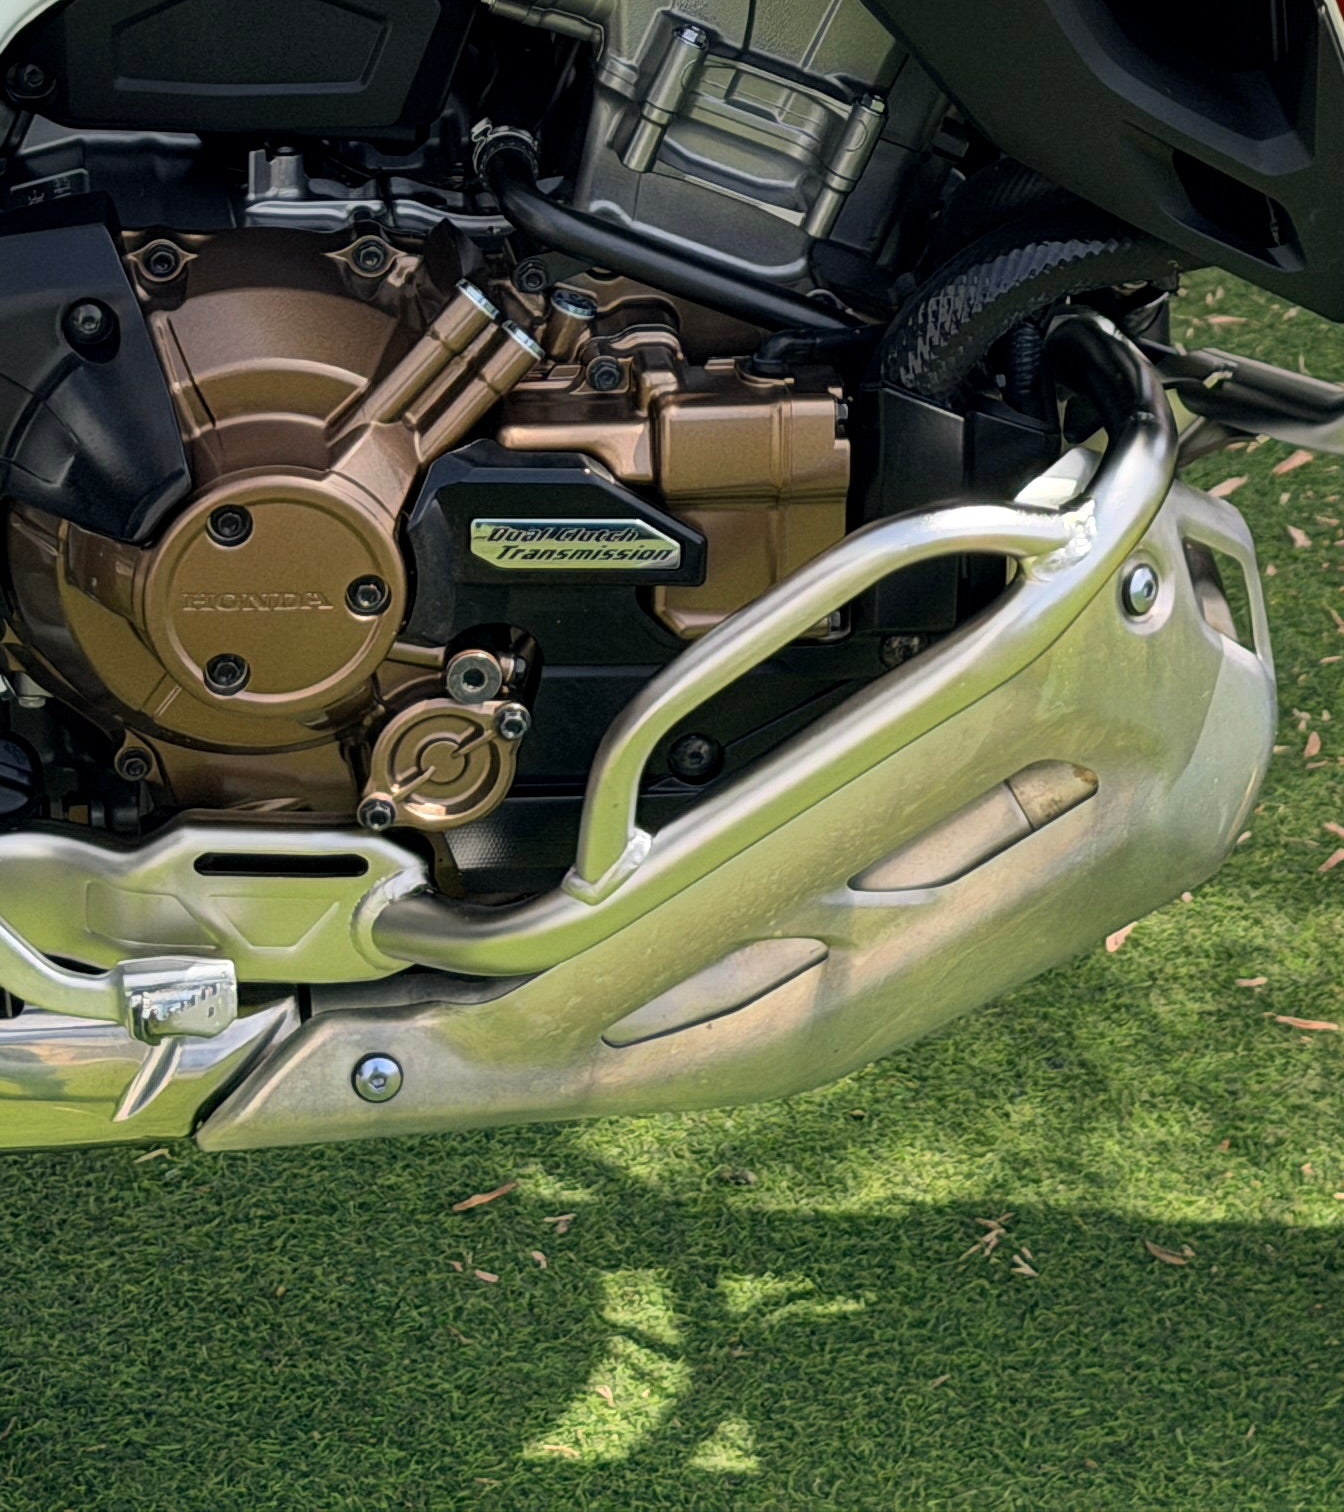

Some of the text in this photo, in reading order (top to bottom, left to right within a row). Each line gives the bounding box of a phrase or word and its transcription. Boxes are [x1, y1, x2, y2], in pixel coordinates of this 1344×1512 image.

[486, 525, 639, 544] Dual Clutch
[496, 544, 675, 561] Transmission
[182, 592, 334, 612] HONDA
